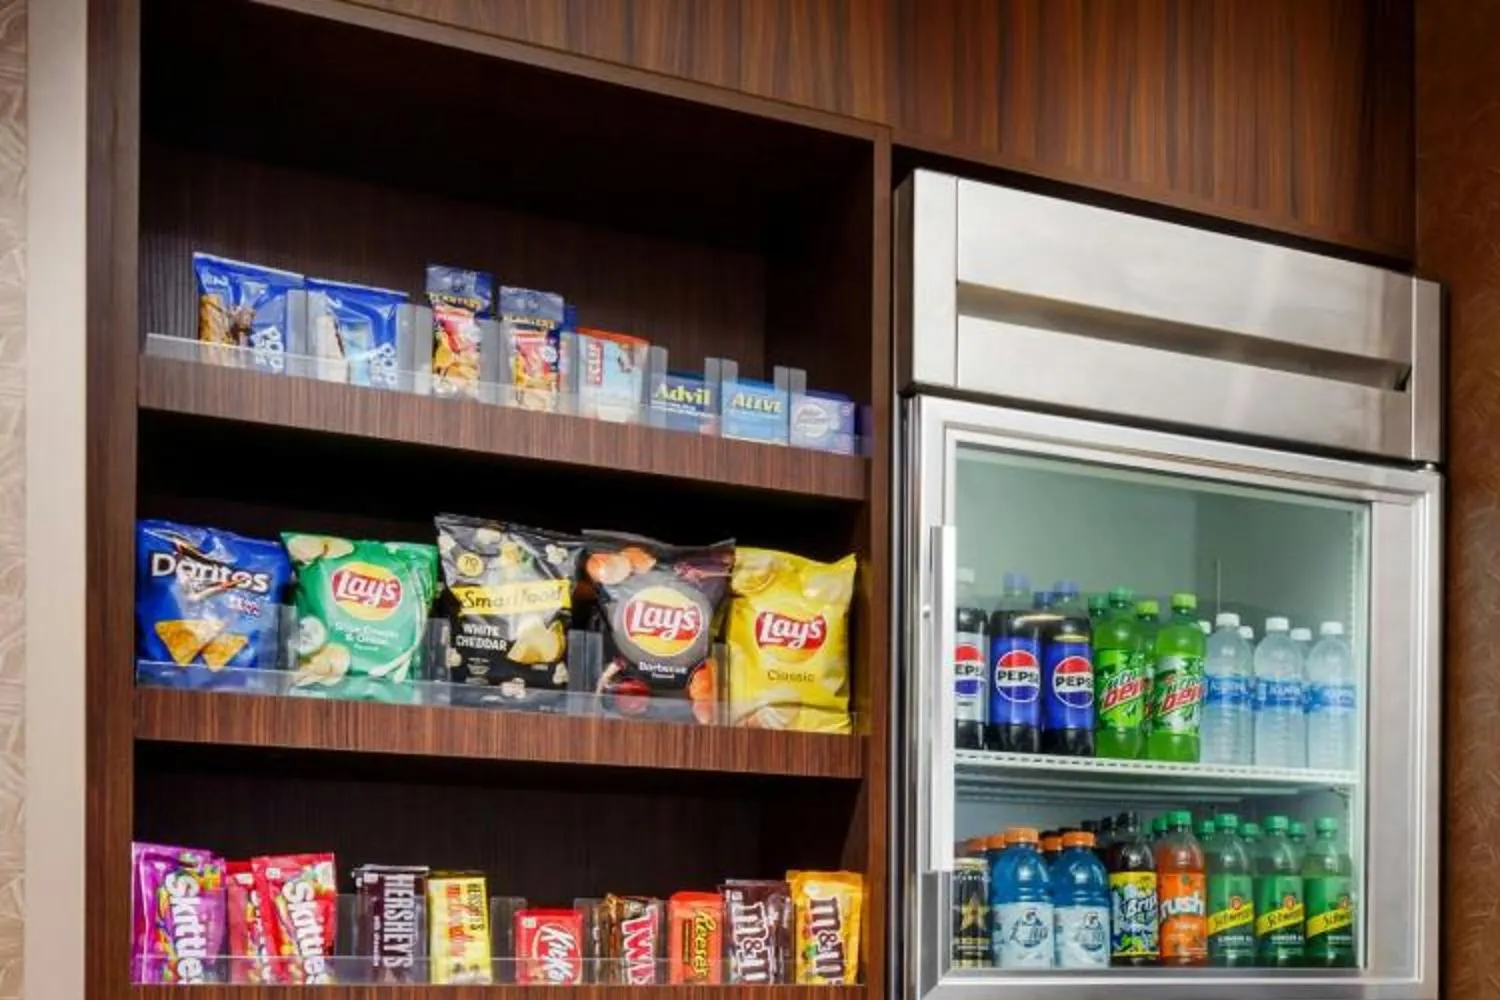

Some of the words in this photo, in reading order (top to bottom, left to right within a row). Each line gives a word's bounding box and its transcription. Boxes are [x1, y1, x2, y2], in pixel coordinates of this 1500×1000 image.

[655, 384, 711, 406] Advil
[151, 552, 269, 593] Doritos
[336, 570, 398, 606] Lay's
[463, 623, 501, 637] WHITE
[630, 600, 697, 640] Lay's
[760, 611, 824, 648] Lay's
[456, 635, 508, 651] CHEDDAR
[383, 873, 416, 968] HERSHEY'S
